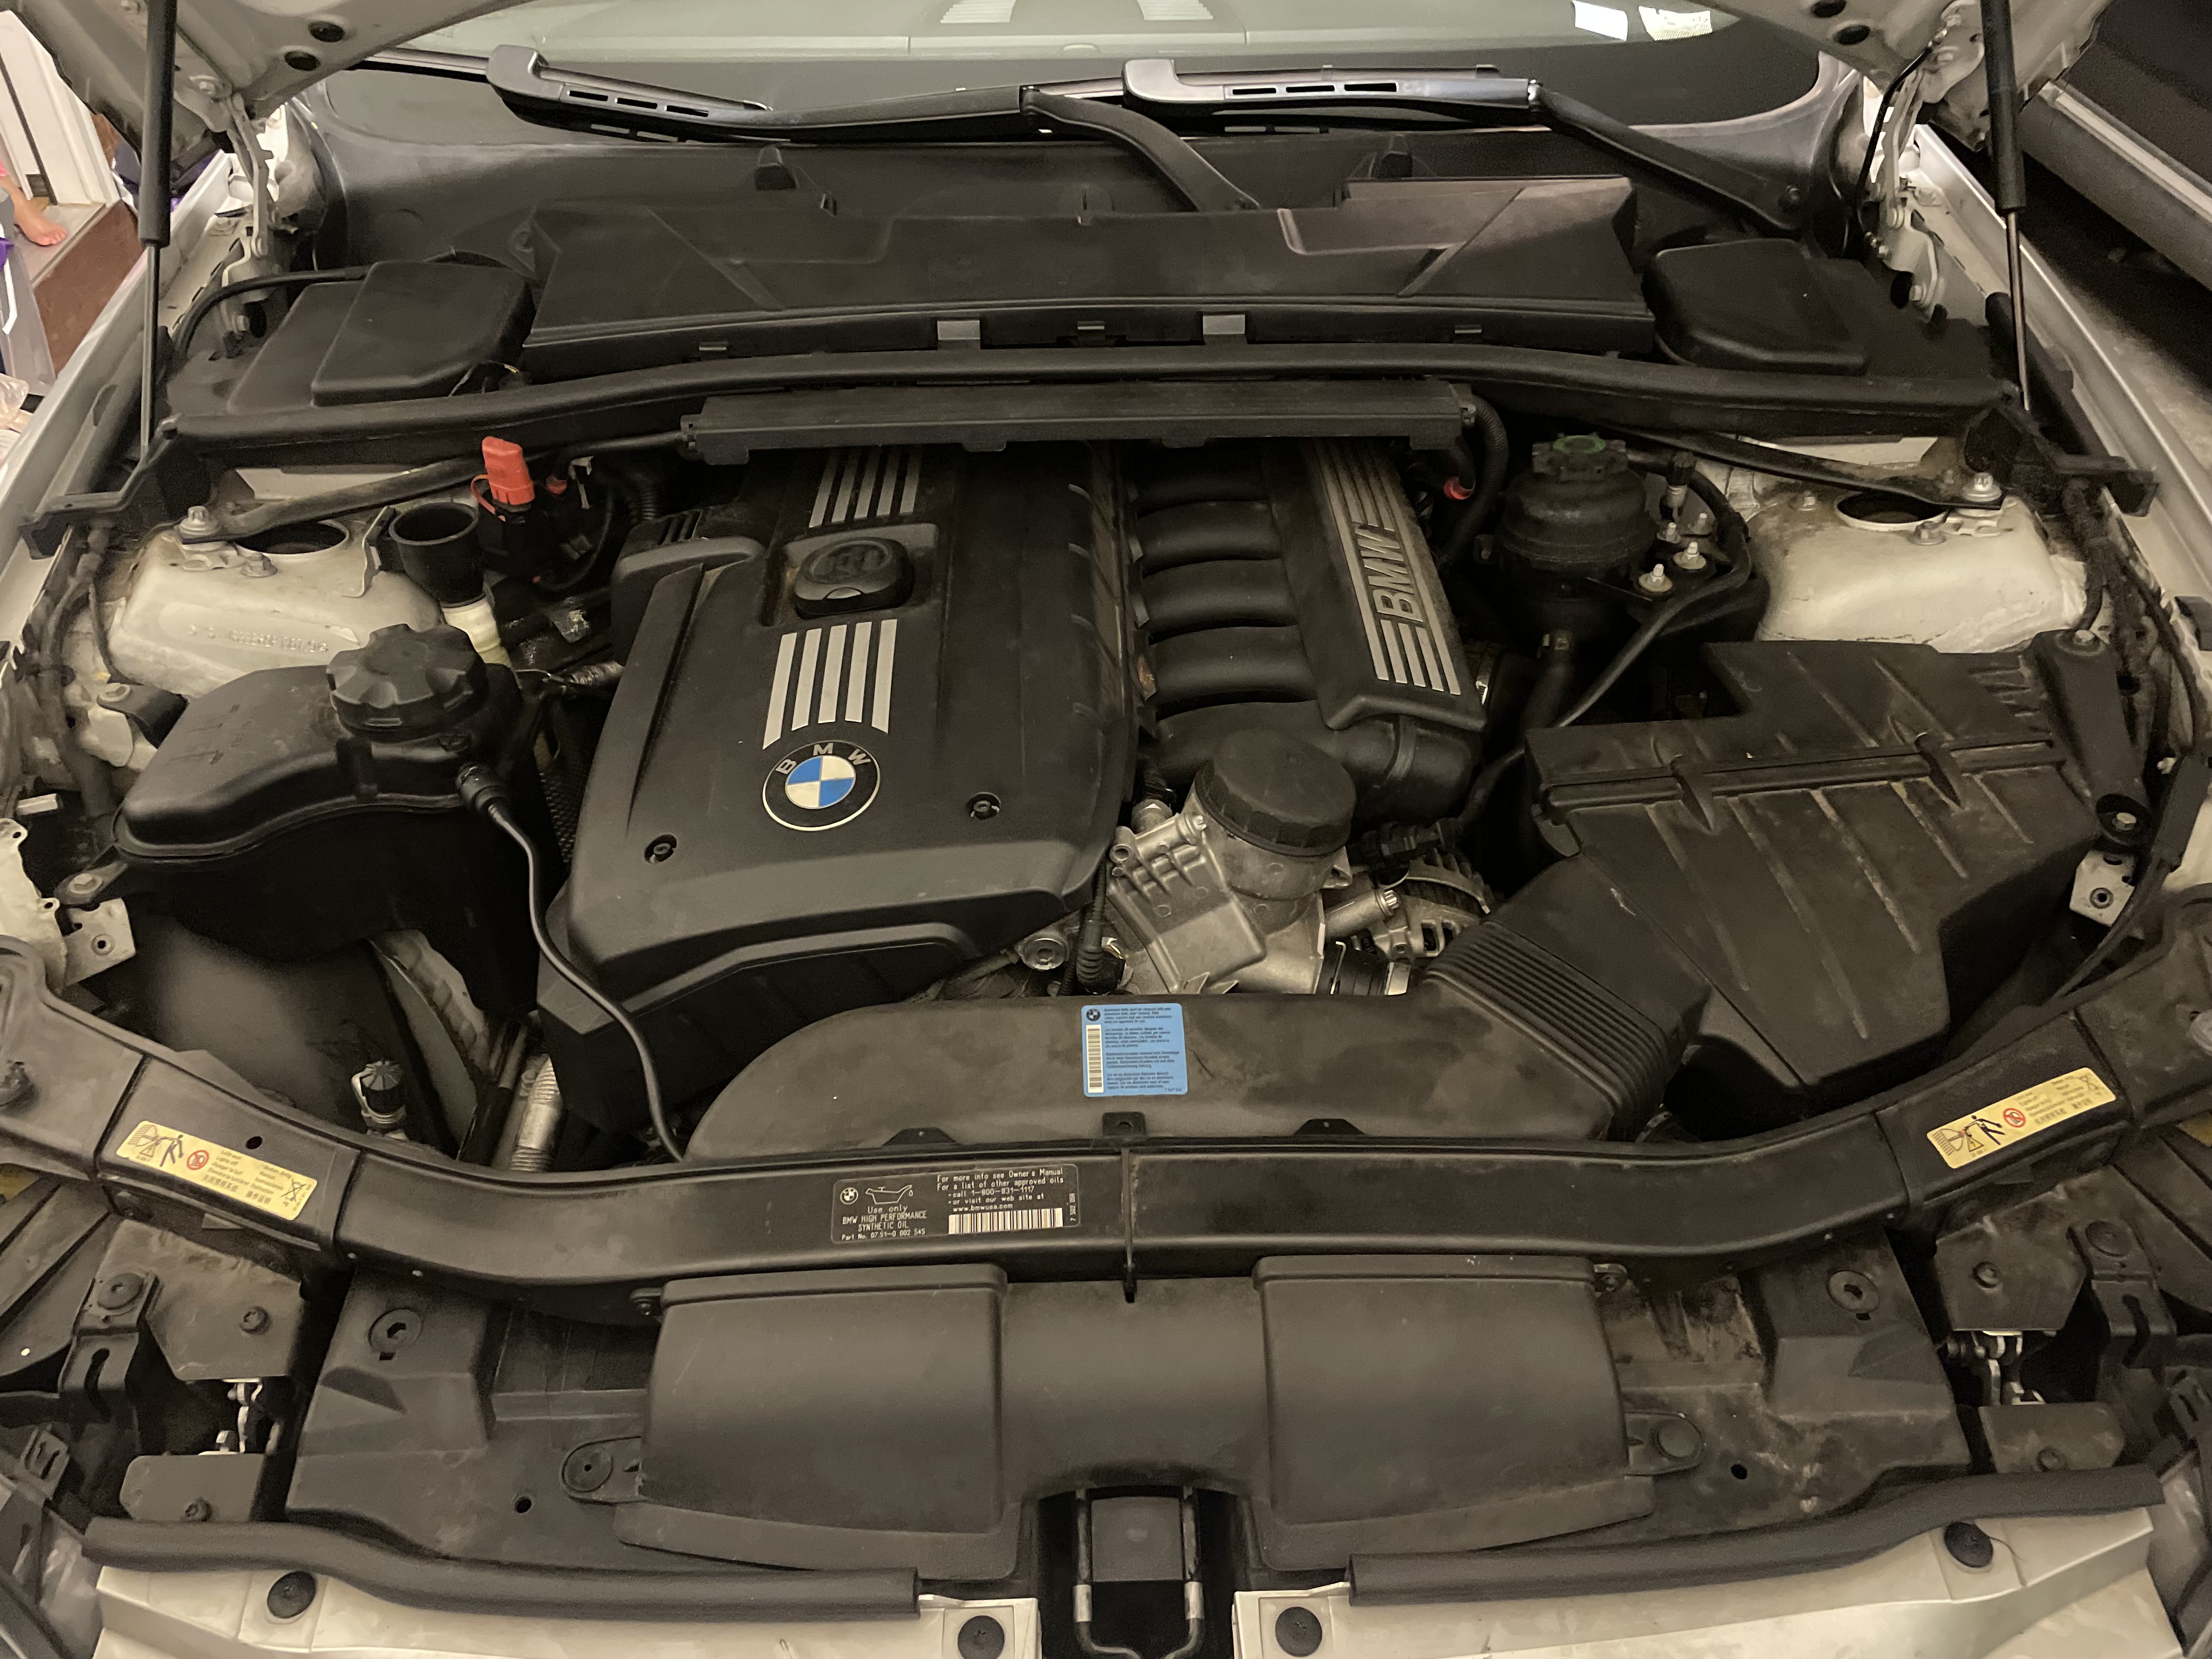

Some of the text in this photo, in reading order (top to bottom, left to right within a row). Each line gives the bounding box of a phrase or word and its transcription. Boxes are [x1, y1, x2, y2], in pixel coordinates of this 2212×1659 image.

[1355, 526, 1424, 623] BMW
[775, 742, 871, 775] BMW
[937, 1175, 949, 1183] For
[974, 1172, 989, 1180] info
[1009, 1169, 1035, 1178] Owner's
[1039, 1166, 1063, 1176] Manual
[937, 1183, 949, 1192] For
[962, 1181, 974, 1189] list
[979, 1180, 986, 1188] of
[991, 1179, 1009, 1187] other
[1014, 1176, 1046, 1187] approved
[1049, 1176, 1064, 1184] oils
[952, 1189, 967, 1198] call
[1018, 1193, 1032, 1201] site
[888, 1204, 908, 1213] only
[842, 1210, 927, 1225] BMW HIGH PERFORMANCE
[857, 1220, 909, 1232] SYNTHETIC OIL
